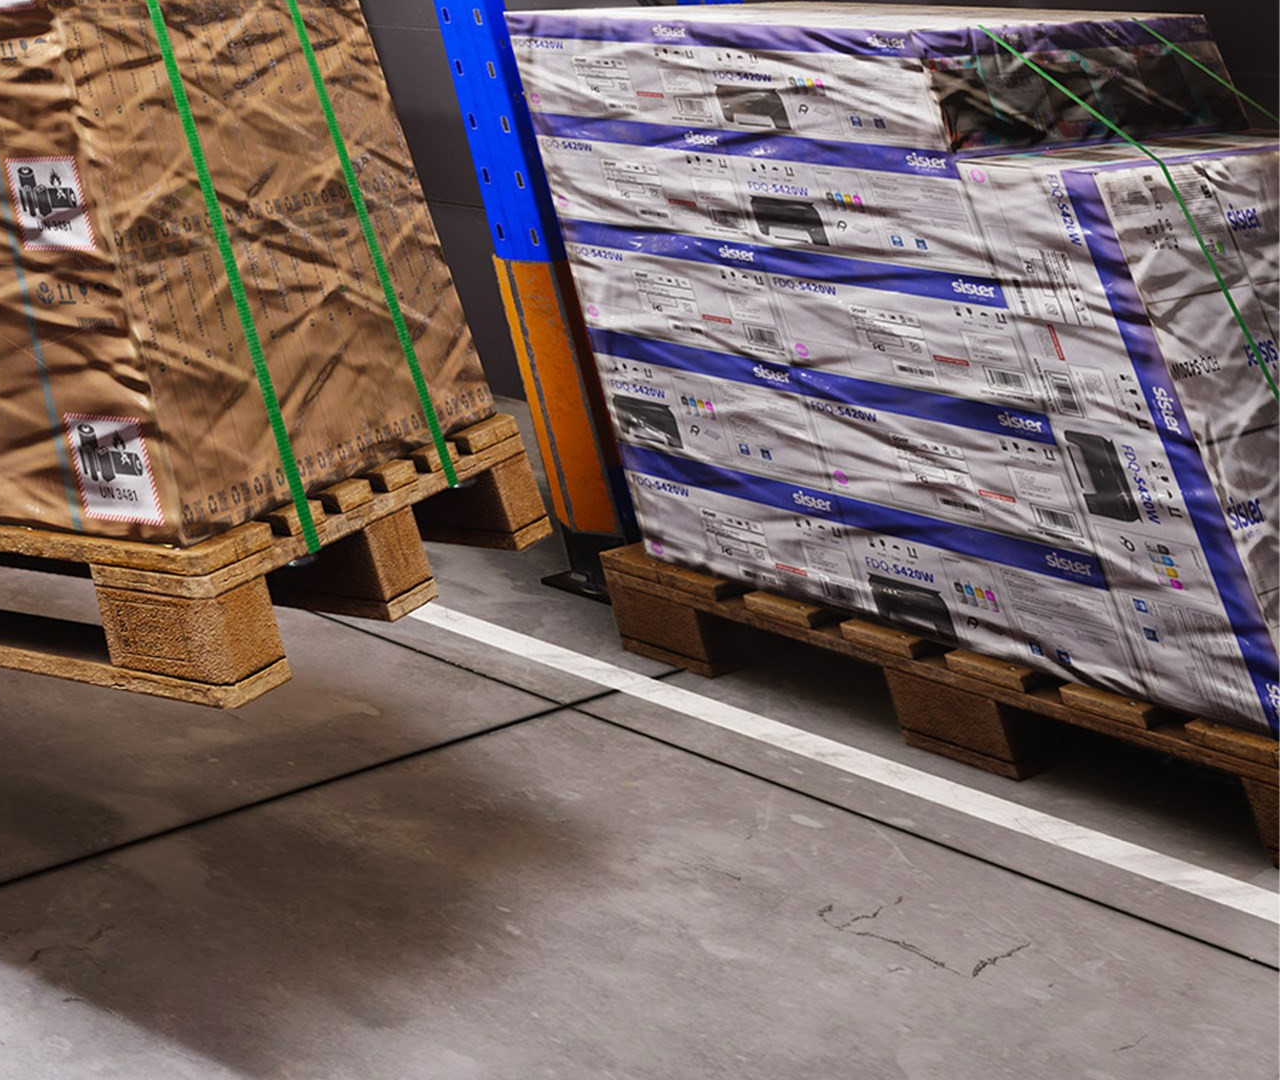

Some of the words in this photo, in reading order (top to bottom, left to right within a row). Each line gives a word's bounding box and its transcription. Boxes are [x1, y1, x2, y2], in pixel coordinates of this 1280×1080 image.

[651, 23, 687, 39] sister
[866, 34, 907, 50] sister
[541, 138, 593, 152] FDQ-S420W
[684, 130, 719, 147] sister
[906, 152, 947, 170] sister
[747, 180, 809, 197] FDQ-S420W
[1226, 203, 1263, 232] sister
[718, 244, 755, 263] sister
[772, 276, 837, 297] FDQ-S420W
[951, 278, 995, 299] sister
[752, 364, 790, 384] sister
[610, 378, 666, 400] FDQ-S420W
[810, 400, 878, 423] FDQ-S420W
[1151, 385, 1182, 436] sister
[997, 411, 1043, 433] sister
[99, 485, 115, 500] UN
[115, 486, 139, 502] 3481
[631, 473, 690, 498] FDQ-S420W
[1121, 444, 1161, 525] FDQ-S420W
[793, 490, 832, 511] sister
[1227, 496, 1266, 531] sister
[865, 556, 935, 584] FDQ-S420W
[1044, 551, 1092, 577] sister
